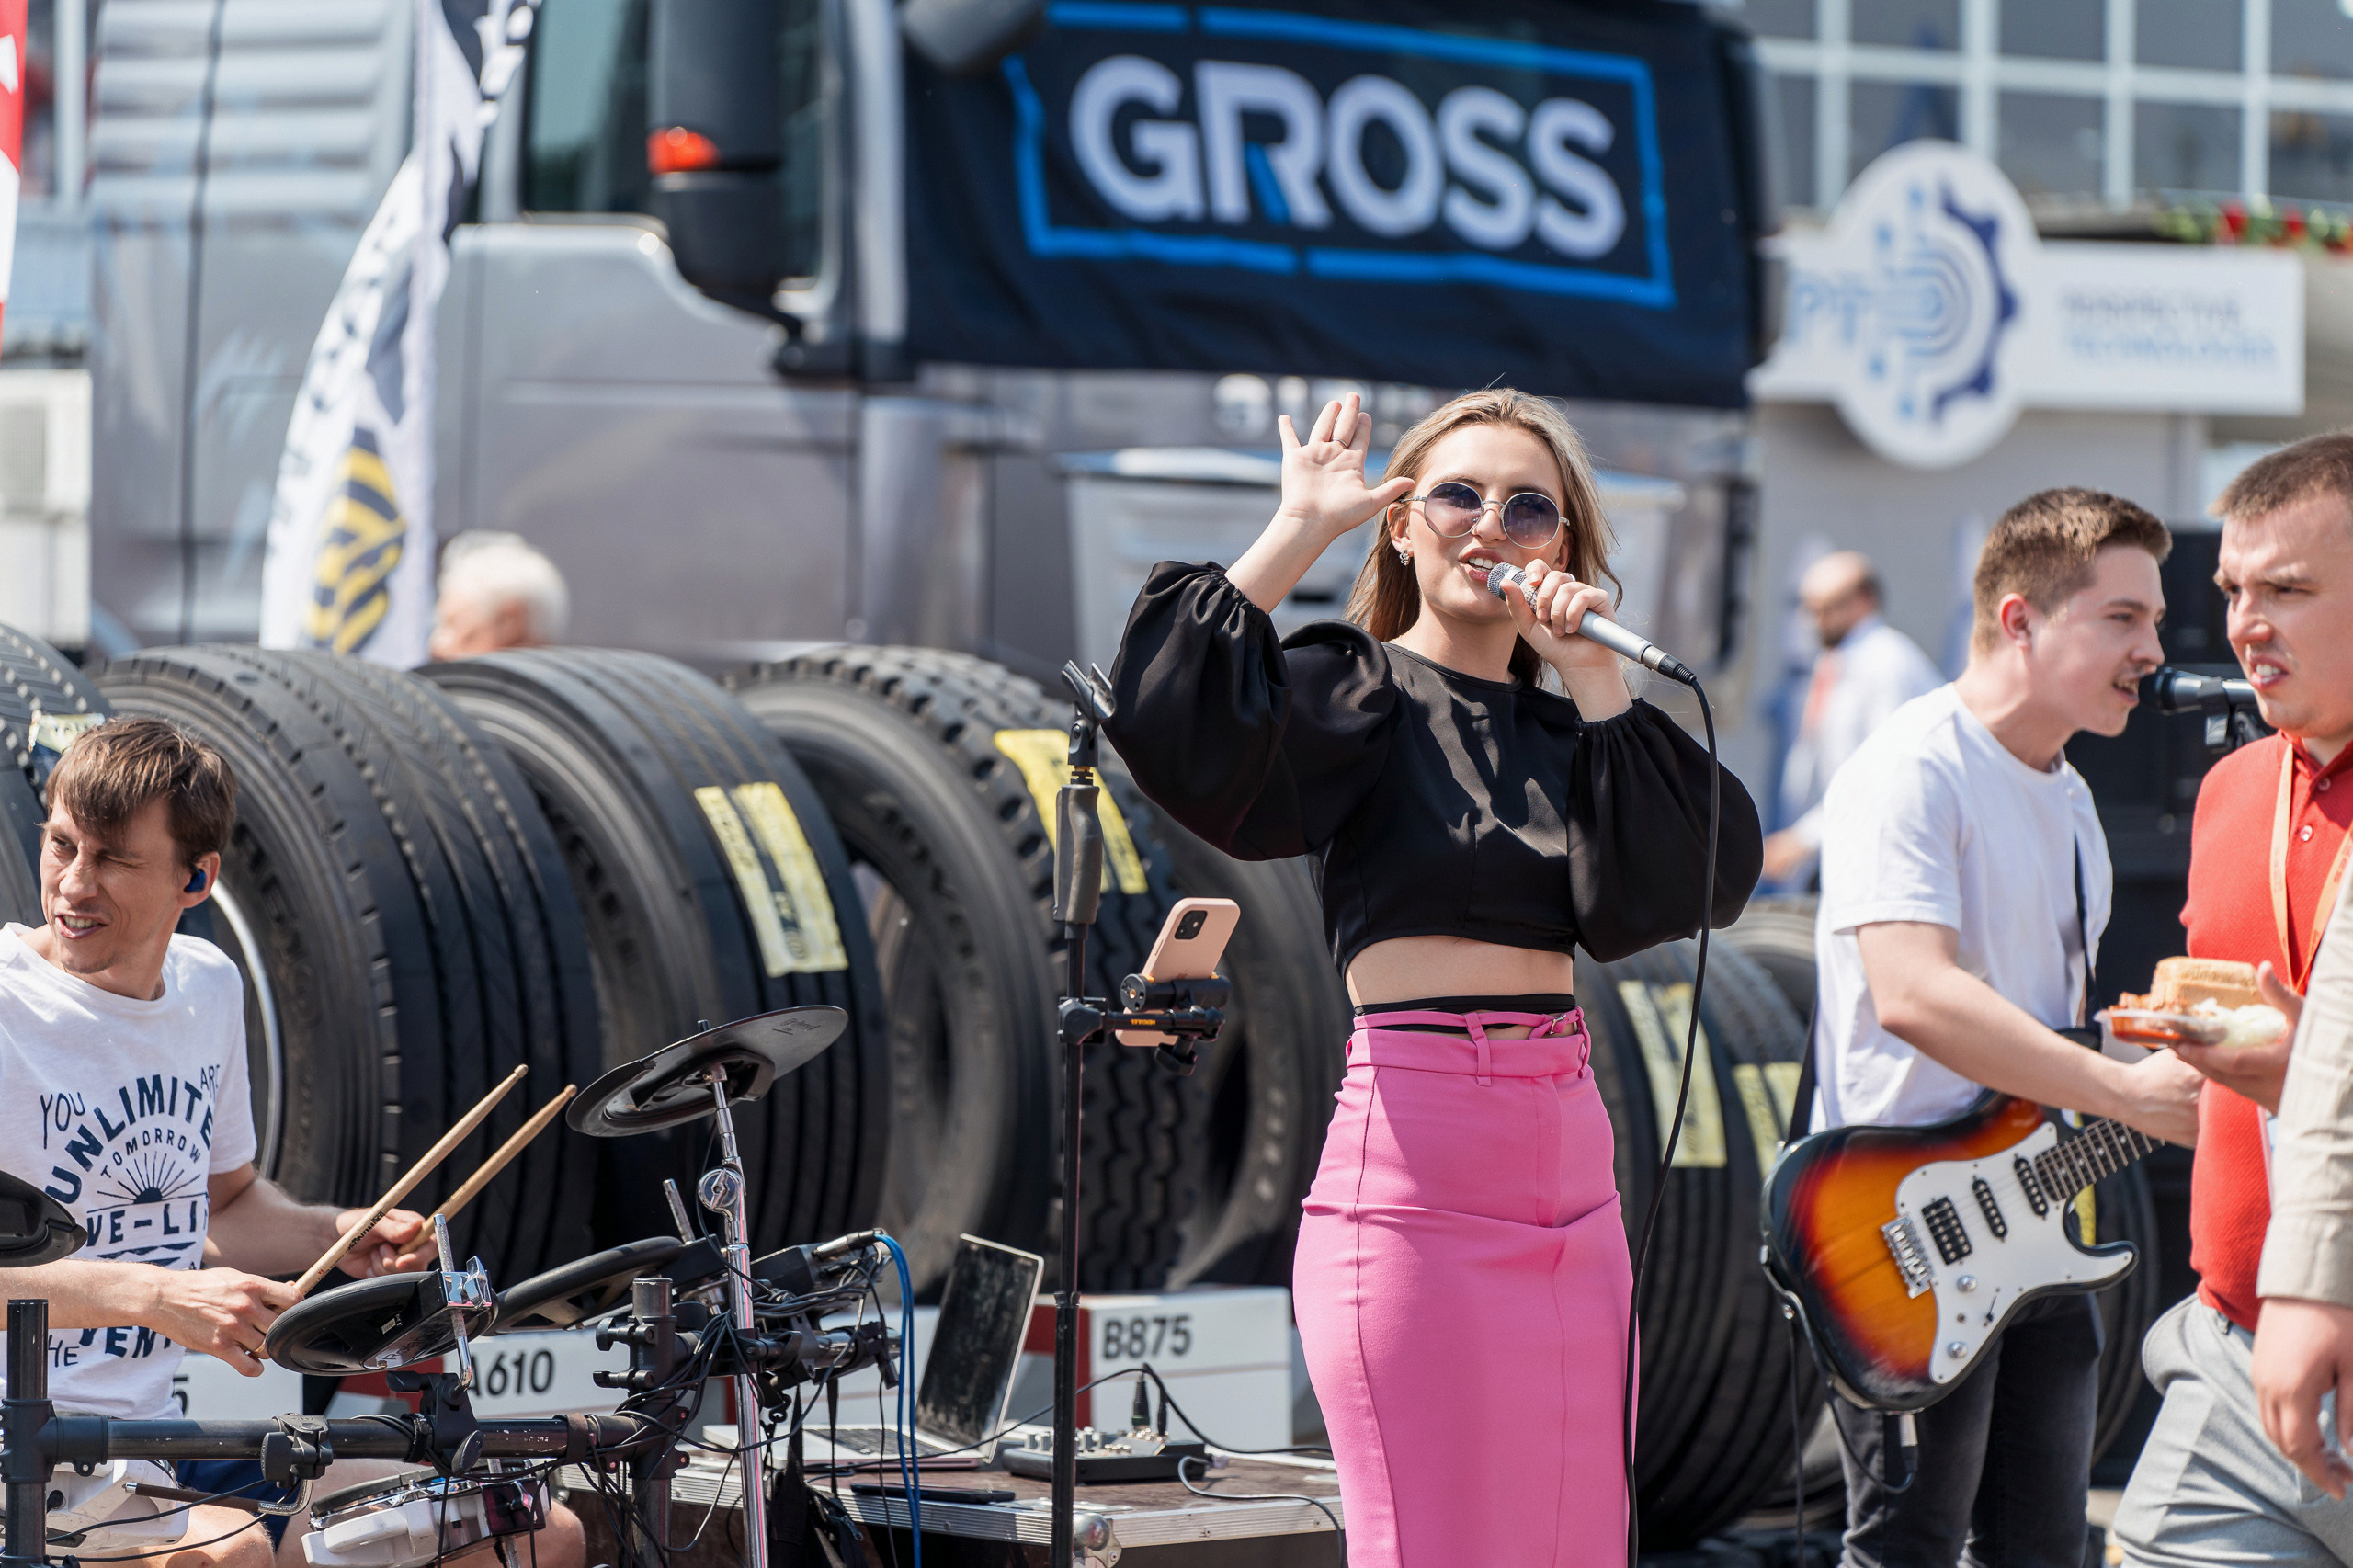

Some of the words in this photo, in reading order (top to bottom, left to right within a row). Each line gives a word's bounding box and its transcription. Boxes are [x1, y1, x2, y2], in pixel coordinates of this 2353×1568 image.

[1069, 53, 1627, 258] GROSS
[40, 1091, 85, 1149] YOU
[100, 1127, 201, 1179] TOMORROW
[1103, 1314, 1192, 1360] B875
